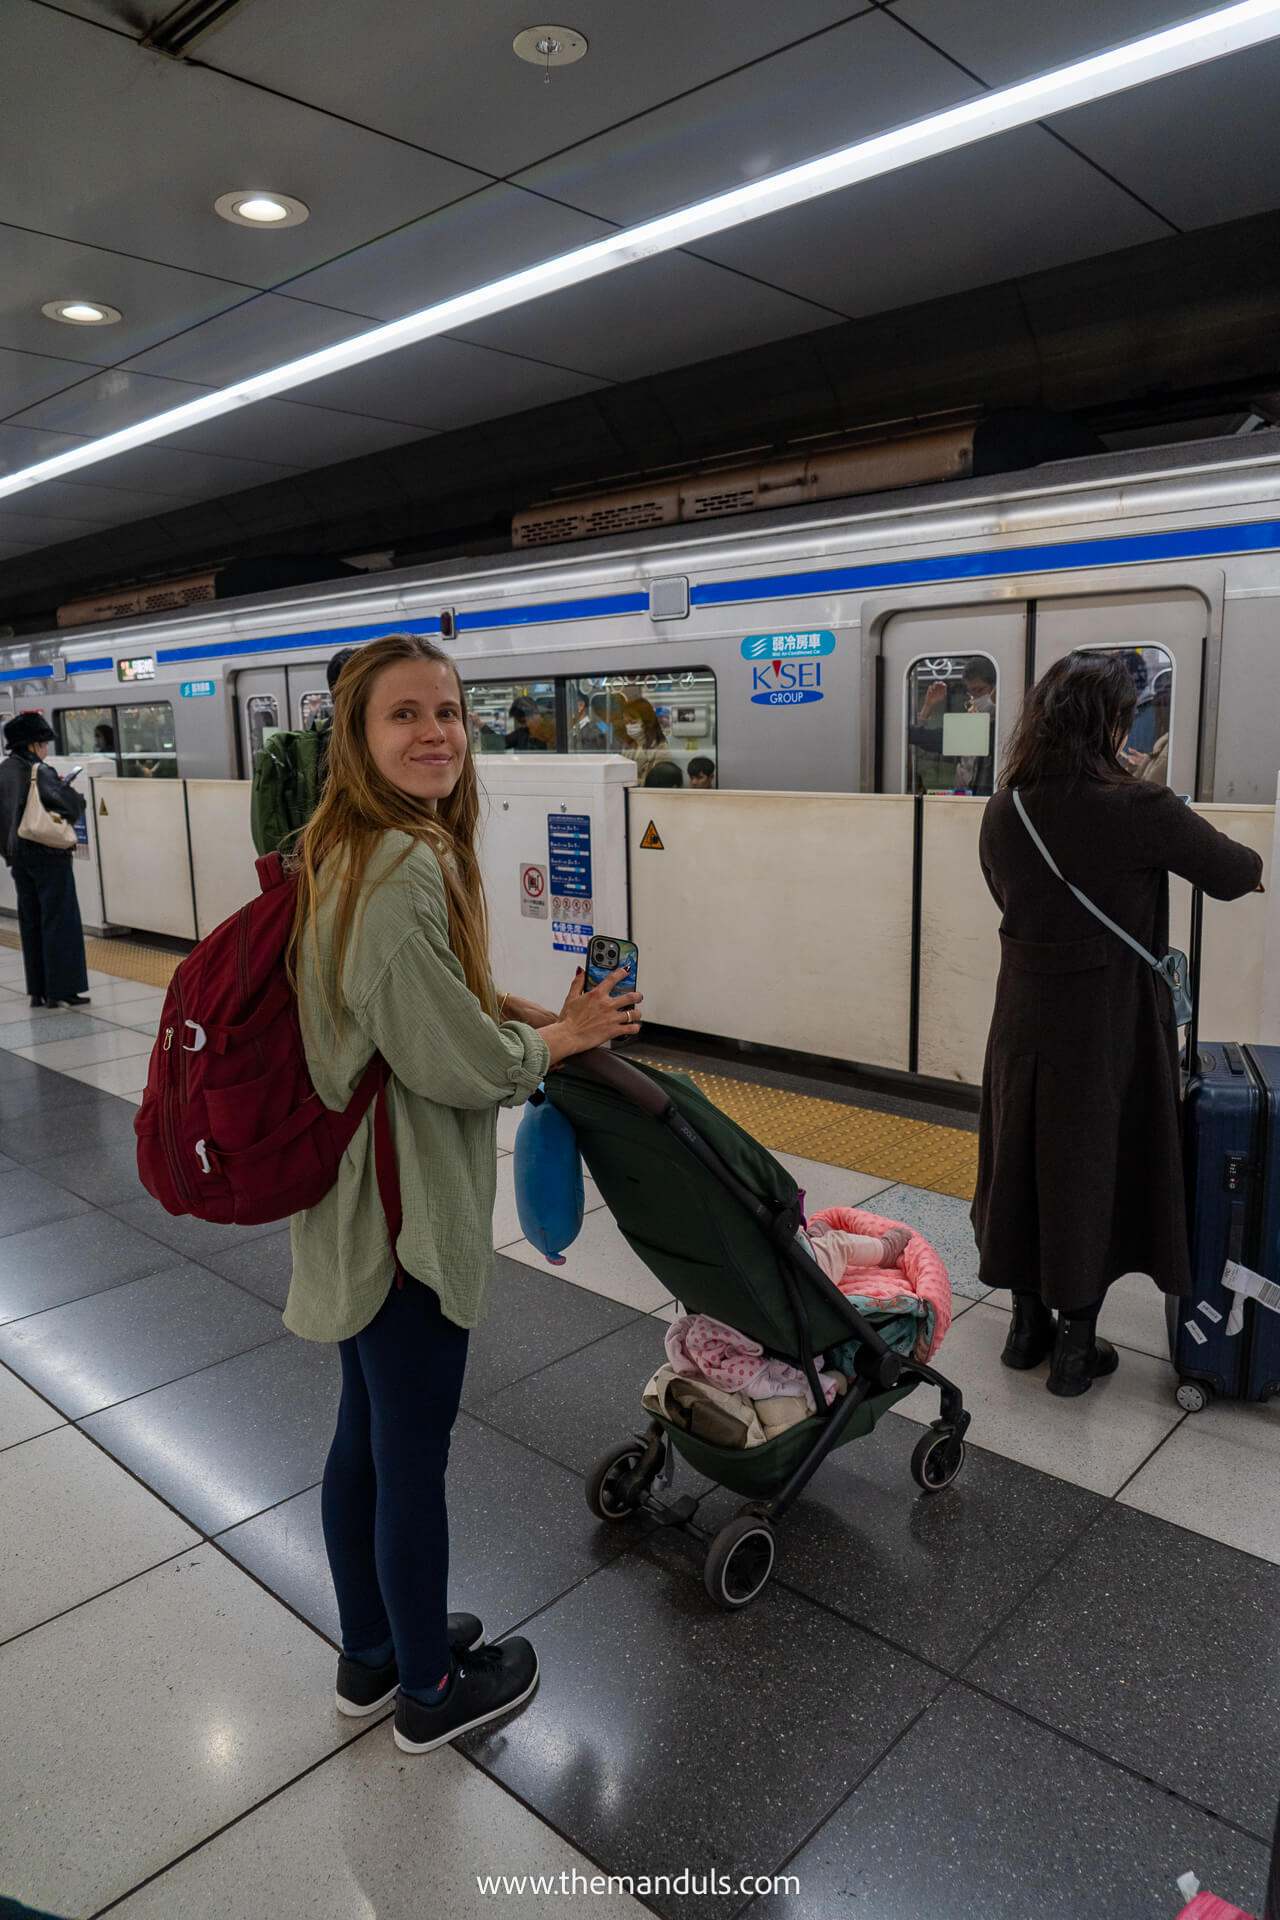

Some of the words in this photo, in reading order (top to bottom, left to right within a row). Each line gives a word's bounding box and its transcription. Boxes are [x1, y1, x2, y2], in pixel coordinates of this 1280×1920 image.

[772, 634, 821, 651] 弱冷房車
[770, 692, 804, 704] GROUP
